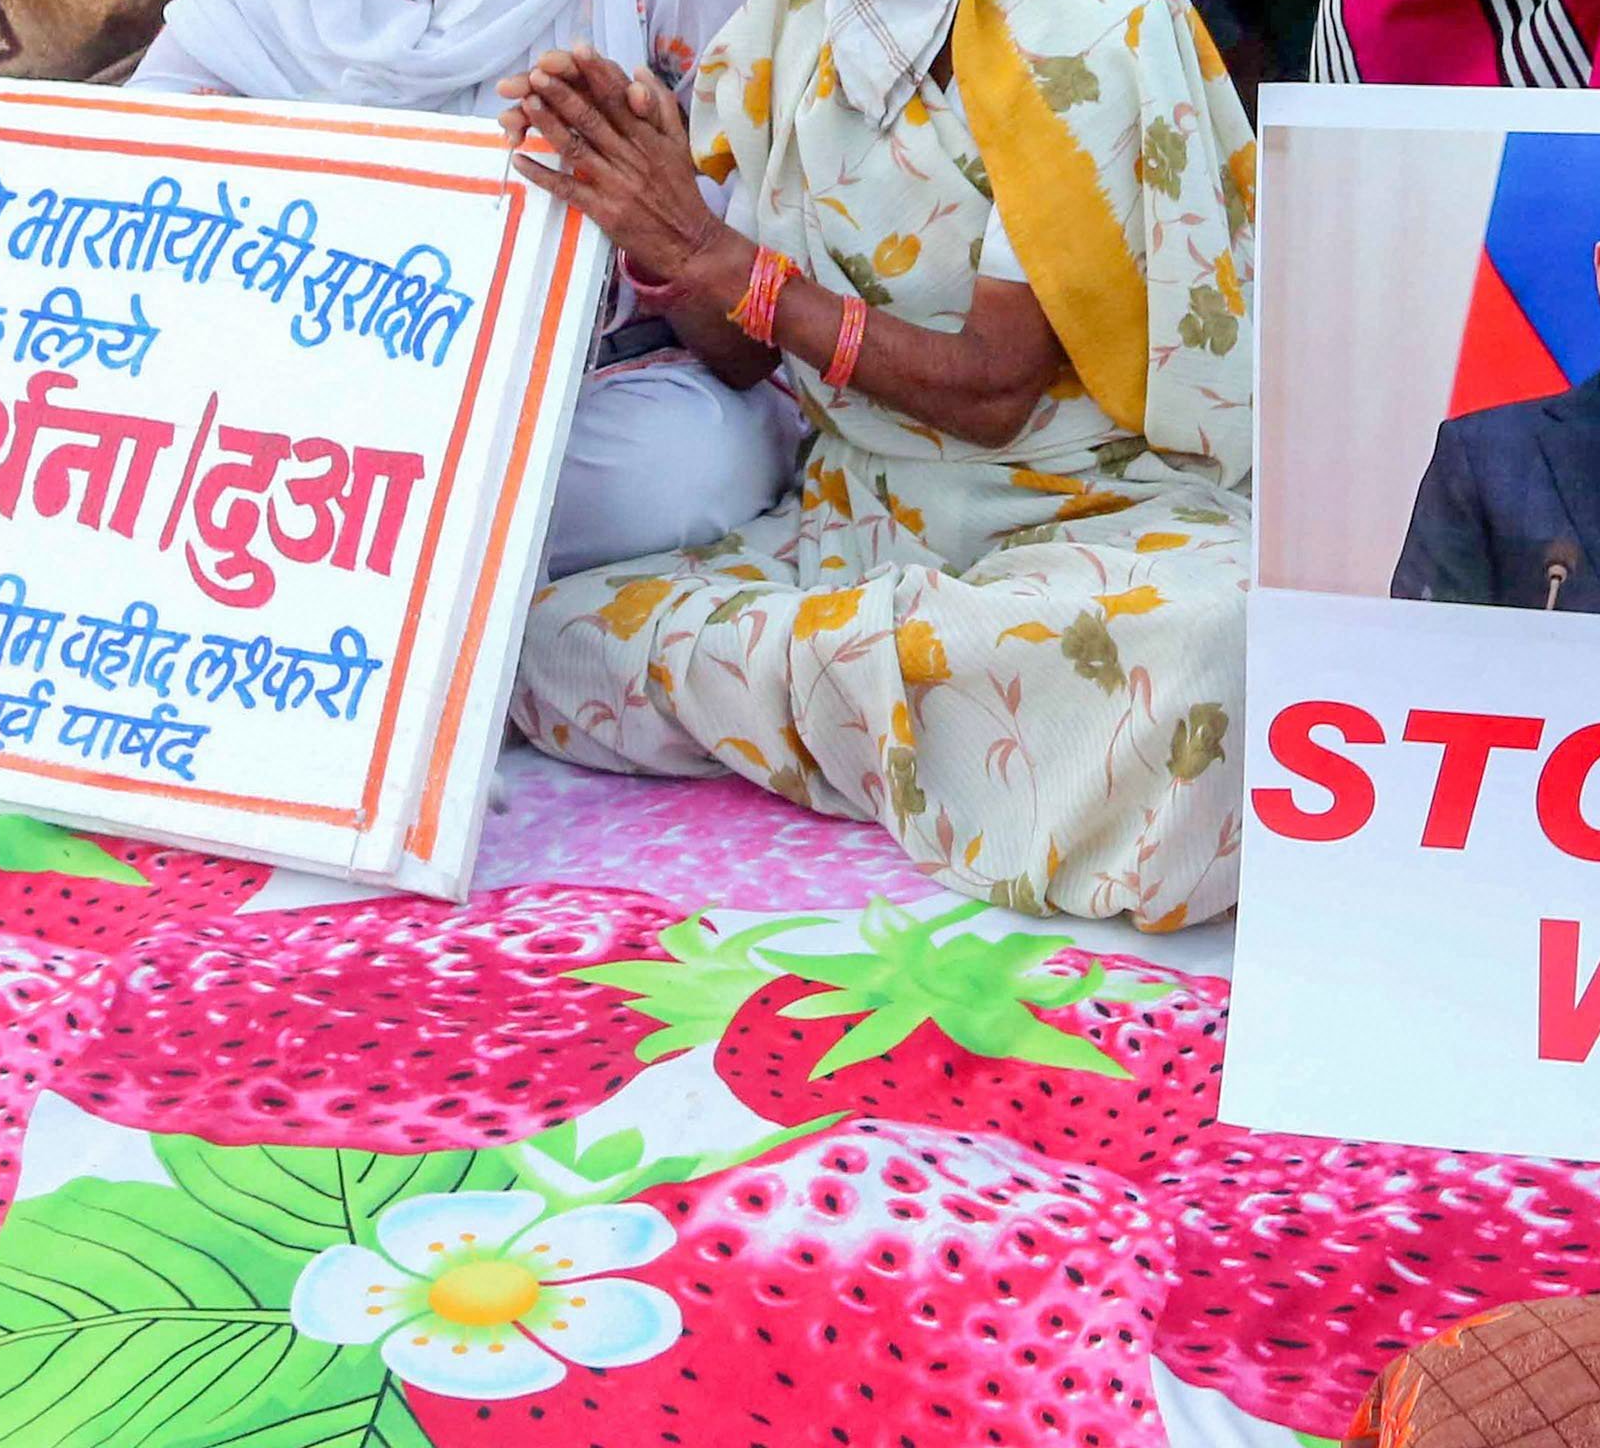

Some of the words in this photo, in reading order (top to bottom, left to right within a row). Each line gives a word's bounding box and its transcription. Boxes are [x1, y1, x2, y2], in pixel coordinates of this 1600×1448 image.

[7, 176, 251, 283] भारतीयों
[232, 198, 320, 303] की
[290, 243, 476, 368] सुरक्षित
[12, 286, 161, 377] लिये
[60, 600, 191, 697] वहीद
[58, 703, 212, 782] पार्षद
